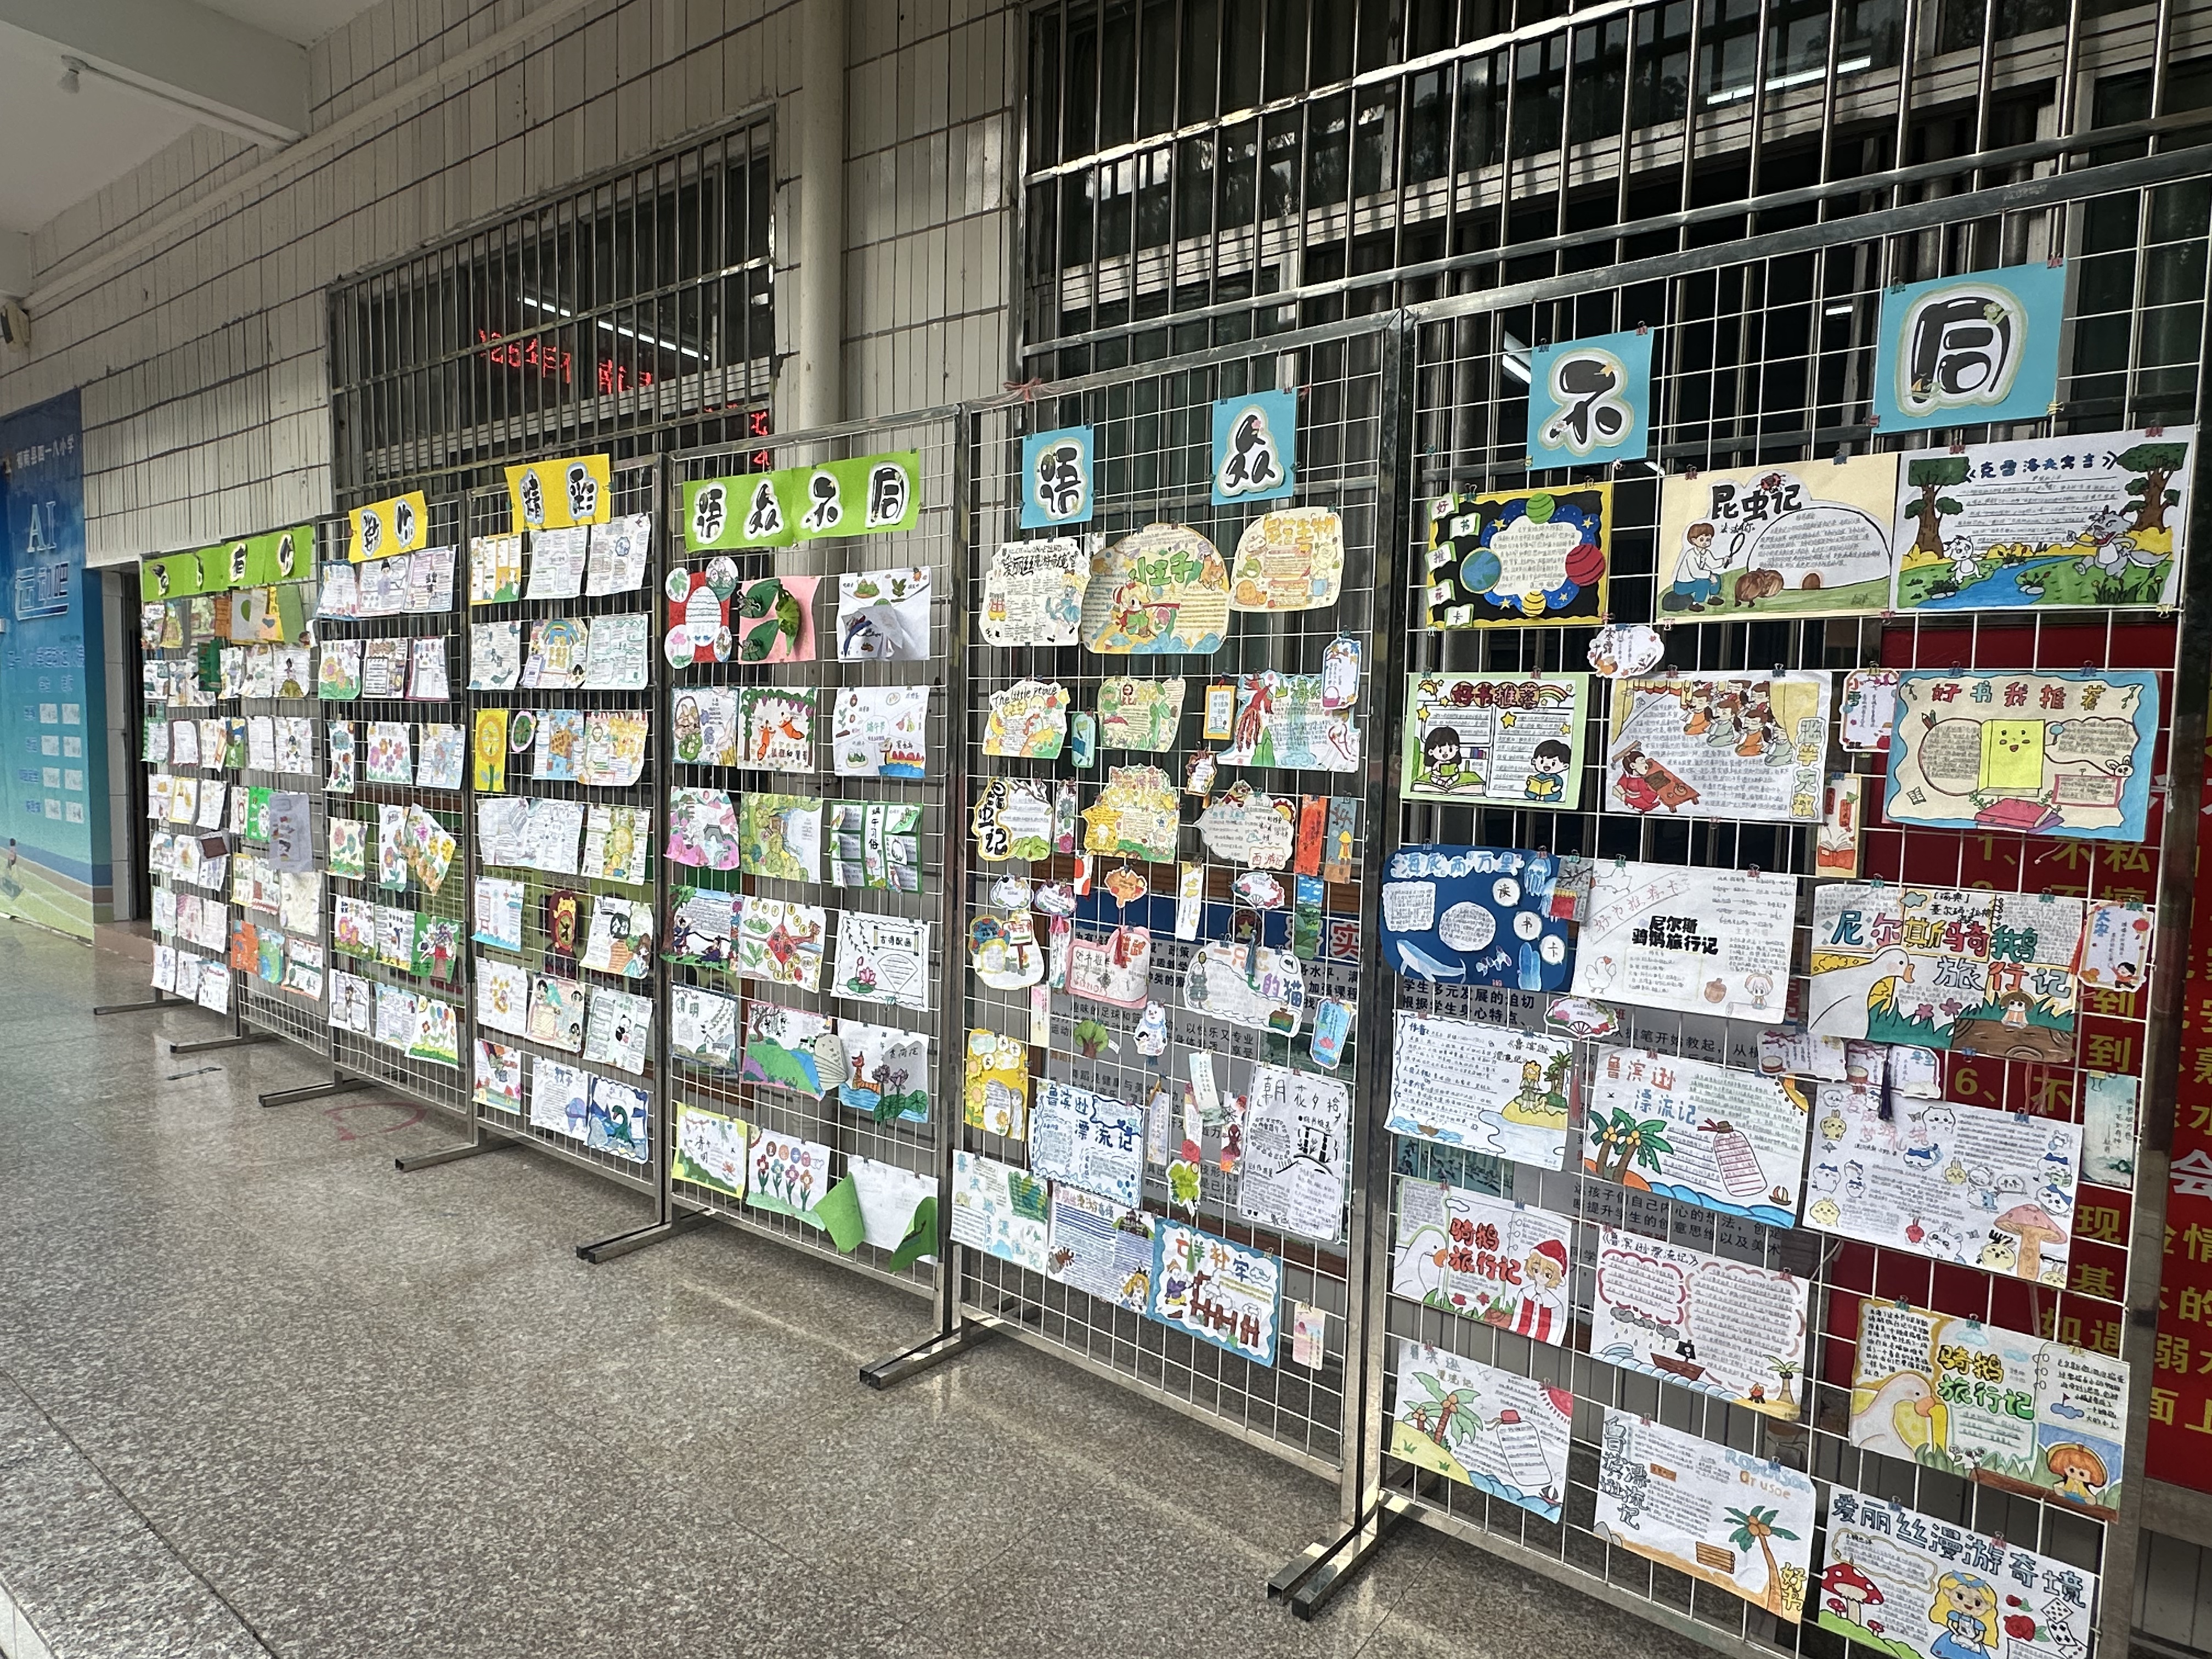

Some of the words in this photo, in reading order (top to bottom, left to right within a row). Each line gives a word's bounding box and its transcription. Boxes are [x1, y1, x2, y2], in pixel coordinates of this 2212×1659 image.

[1548, 359, 1624, 445] 不
[1909, 295, 2013, 405] 同
[1711, 484, 1802, 522] 昆虫记
[27, 501, 57, 552] AI
[1128, 550, 1194, 586] 小王子
[993, 695, 1010, 707] The
[1451, 681, 1541, 708] 好书推荐
[1932, 683, 2107, 711] 好书我推荐
[1251, 852, 1286, 868] 西游记
[1406, 852, 1516, 878] 海底两万里
[1593, 879, 1679, 933] 好书推荐卡
[880, 935, 912, 947] 古诗配画
[1631, 929, 1719, 955] 骑鹅旅行记
[1649, 916, 1699, 935] 尼尔斯
[1830, 910, 2038, 963] 尼尔斯骑鹅
[1403, 978, 1534, 1009] 学生多元发展的迫切
[1933, 956, 2072, 1000] 旅行记
[2086, 1034, 2132, 1072] 到
[1606, 1054, 1677, 1091] 鲁滨逊
[1262, 1074, 1340, 1114] 朝花夕拾
[1634, 1088, 1696, 1125] 漂流记
[1074, 1118, 1133, 1153] 漂流记
[1449, 1217, 1500, 1252] 骑鹅
[1175, 1231, 1250, 1283] 亡羊补牢
[1448, 1245, 1522, 1286] 旅行记
[1937, 1344, 2005, 1384] 骑鹅
[1938, 1374, 2035, 1421] 旅行记
[1833, 1493, 2086, 1609] 爱丽丝漫游奇境
[1779, 1562, 1807, 1612] 好书
